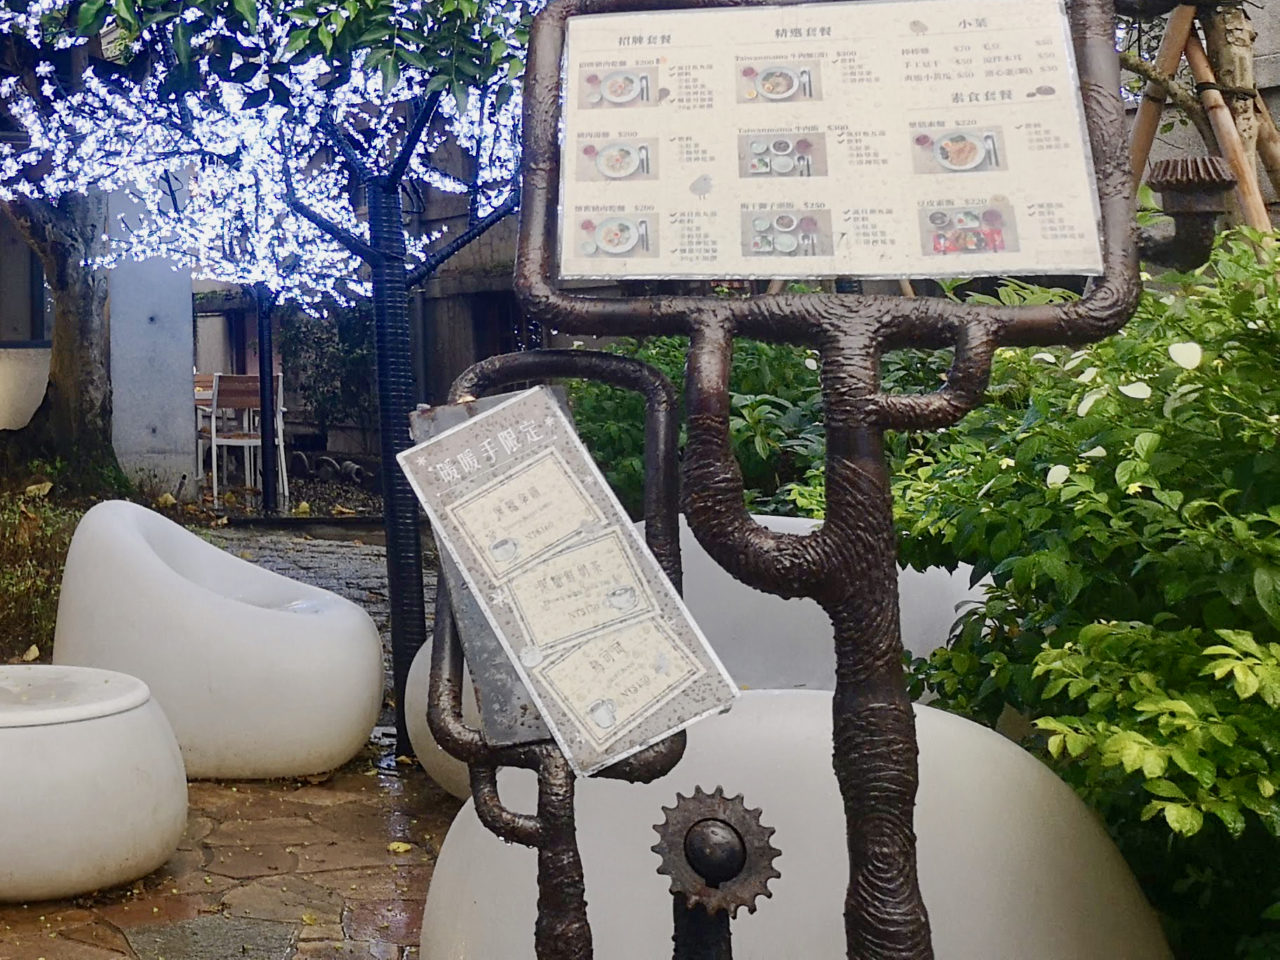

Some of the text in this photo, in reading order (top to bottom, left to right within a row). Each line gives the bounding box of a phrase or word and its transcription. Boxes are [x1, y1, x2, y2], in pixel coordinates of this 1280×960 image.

[618, 34, 672, 47] 招牌套餐
[435, 419, 544, 483] 暖暖手限定
